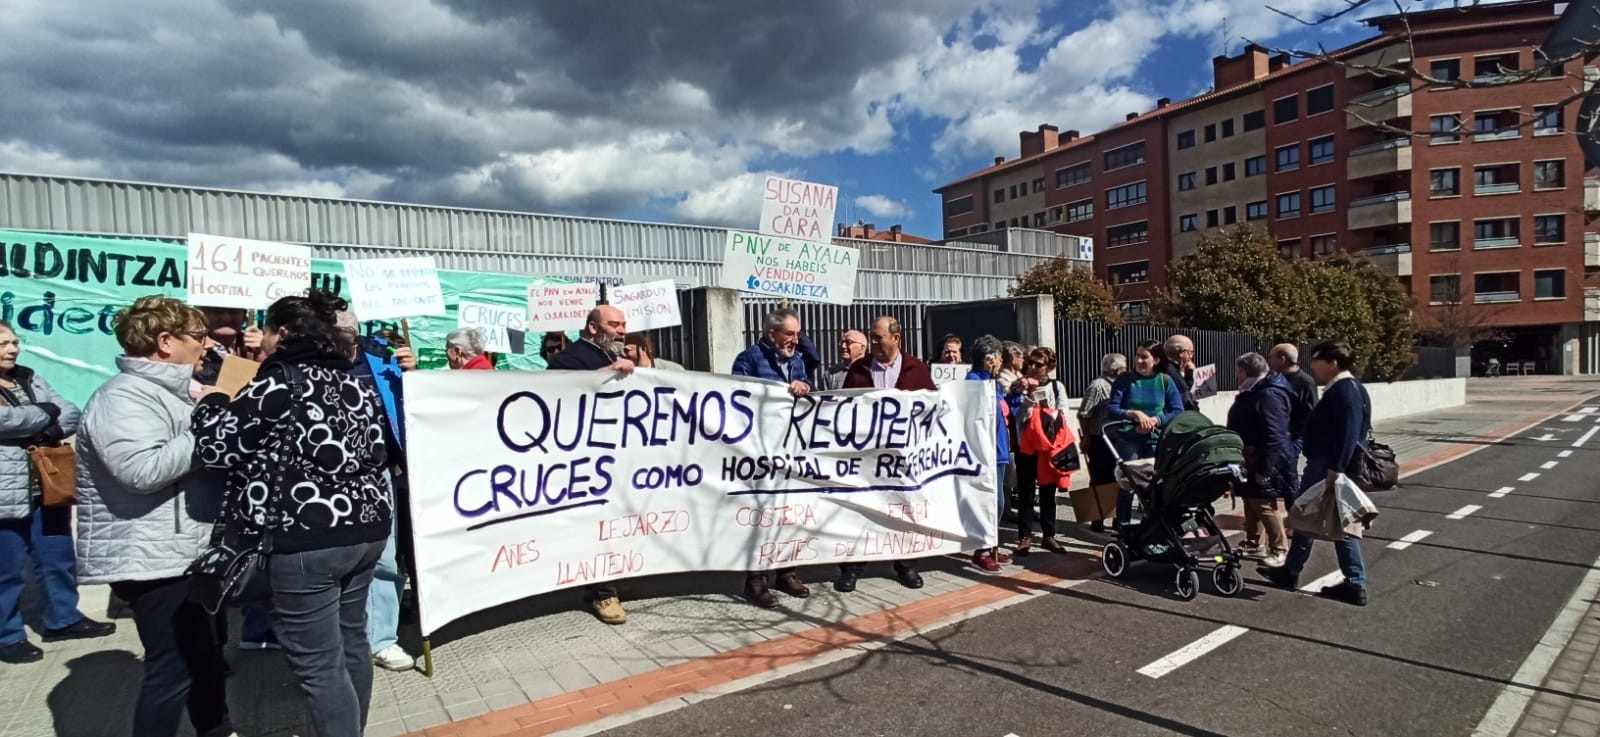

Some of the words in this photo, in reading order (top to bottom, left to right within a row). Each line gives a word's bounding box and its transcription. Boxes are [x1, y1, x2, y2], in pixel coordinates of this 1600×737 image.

[766, 178, 834, 211] SUSANA
[783, 205, 800, 217] DA
[804, 207, 818, 218] LA
[772, 215, 822, 239] CARA
[191, 241, 249, 276] 161
[251, 251, 309, 267] PACIENTES
[732, 233, 772, 255] PNV
[777, 242, 791, 252] DE
[799, 242, 851, 266] AYALA
[252, 266, 309, 281] QUEREMOS
[754, 265, 815, 284] VENDIDO
[756, 255, 779, 266] NOS
[785, 259, 828, 274] HABEIS
[761, 279, 829, 299] OSAKIDETZA
[462, 304, 522, 329] CRUCES
[933, 366, 957, 380] OSI
[496, 386, 755, 453] QUEREMOS
[783, 394, 948, 451] RECUPERAR
[453, 455, 616, 517] CRUCES
[632, 463, 704, 490] COMO
[836, 457, 862, 476] DE
[599, 510, 690, 542] LEJARZO
[735, 503, 817, 529] COSTERA
[556, 550, 644, 586] LLANTENO
[758, 536, 820, 565] RETES
[834, 543, 855, 557] DE
